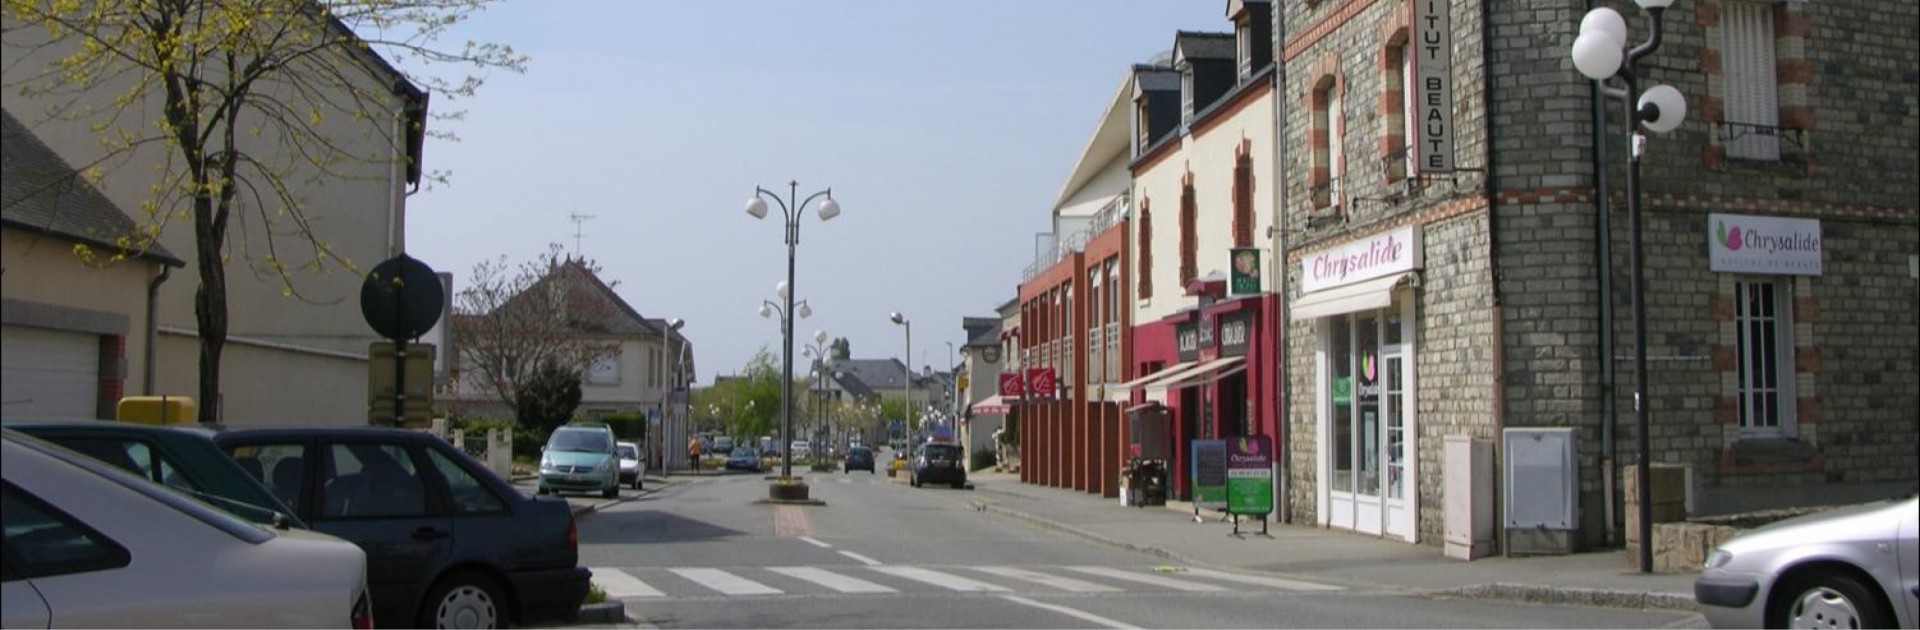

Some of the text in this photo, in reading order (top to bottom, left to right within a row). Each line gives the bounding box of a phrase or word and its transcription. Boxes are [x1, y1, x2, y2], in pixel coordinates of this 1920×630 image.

[1425, 77, 1444, 168] BEAUTE
[1313, 235, 1402, 281] Chrysalide
[1744, 228, 1819, 254] Chrysalide
